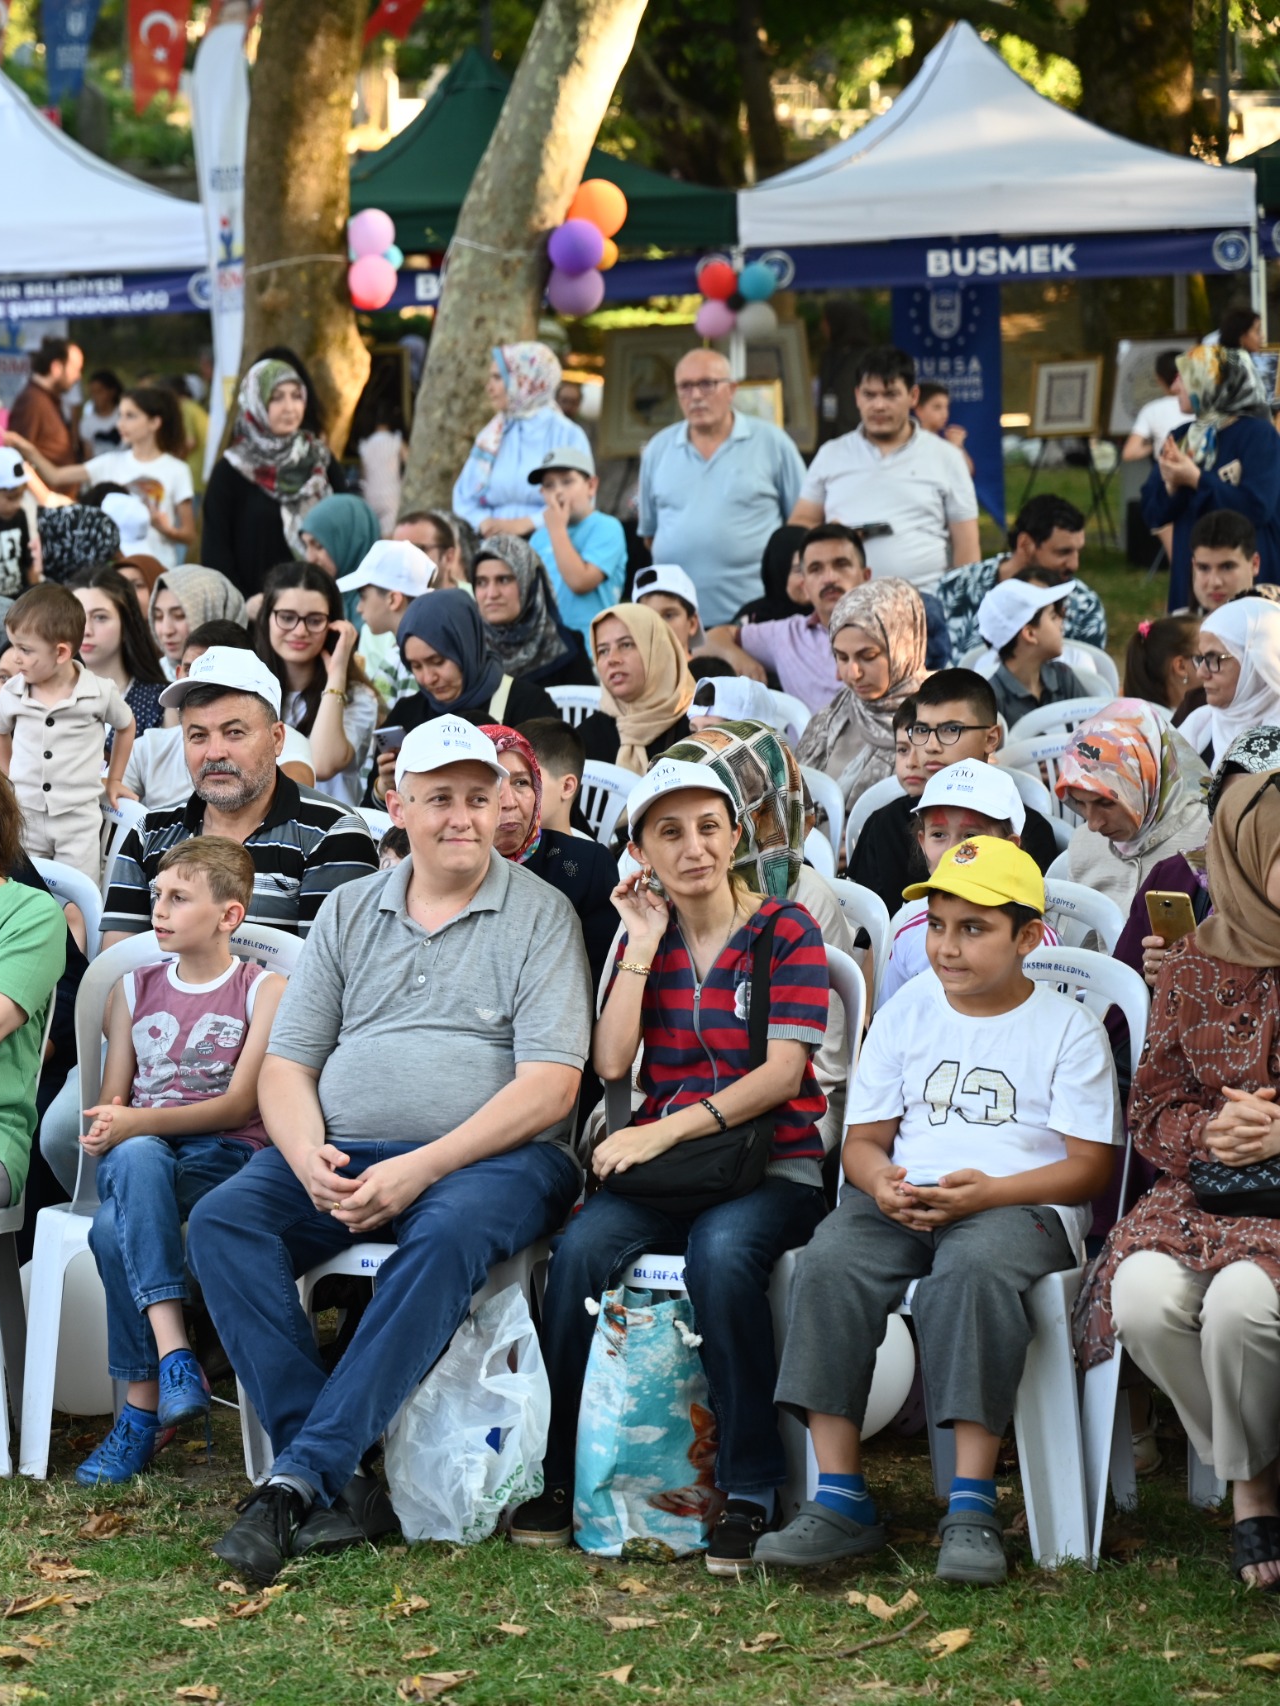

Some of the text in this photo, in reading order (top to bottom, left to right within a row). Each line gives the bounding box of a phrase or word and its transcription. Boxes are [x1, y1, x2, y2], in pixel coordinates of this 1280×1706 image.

[926, 243, 1078, 278] BUSMEK
[23, 275, 125, 299] BELEDİYESİ
[441, 724, 467, 735] 700
[951, 769, 975, 779] 700
[243, 938, 280, 955] BELEDİYESİ
